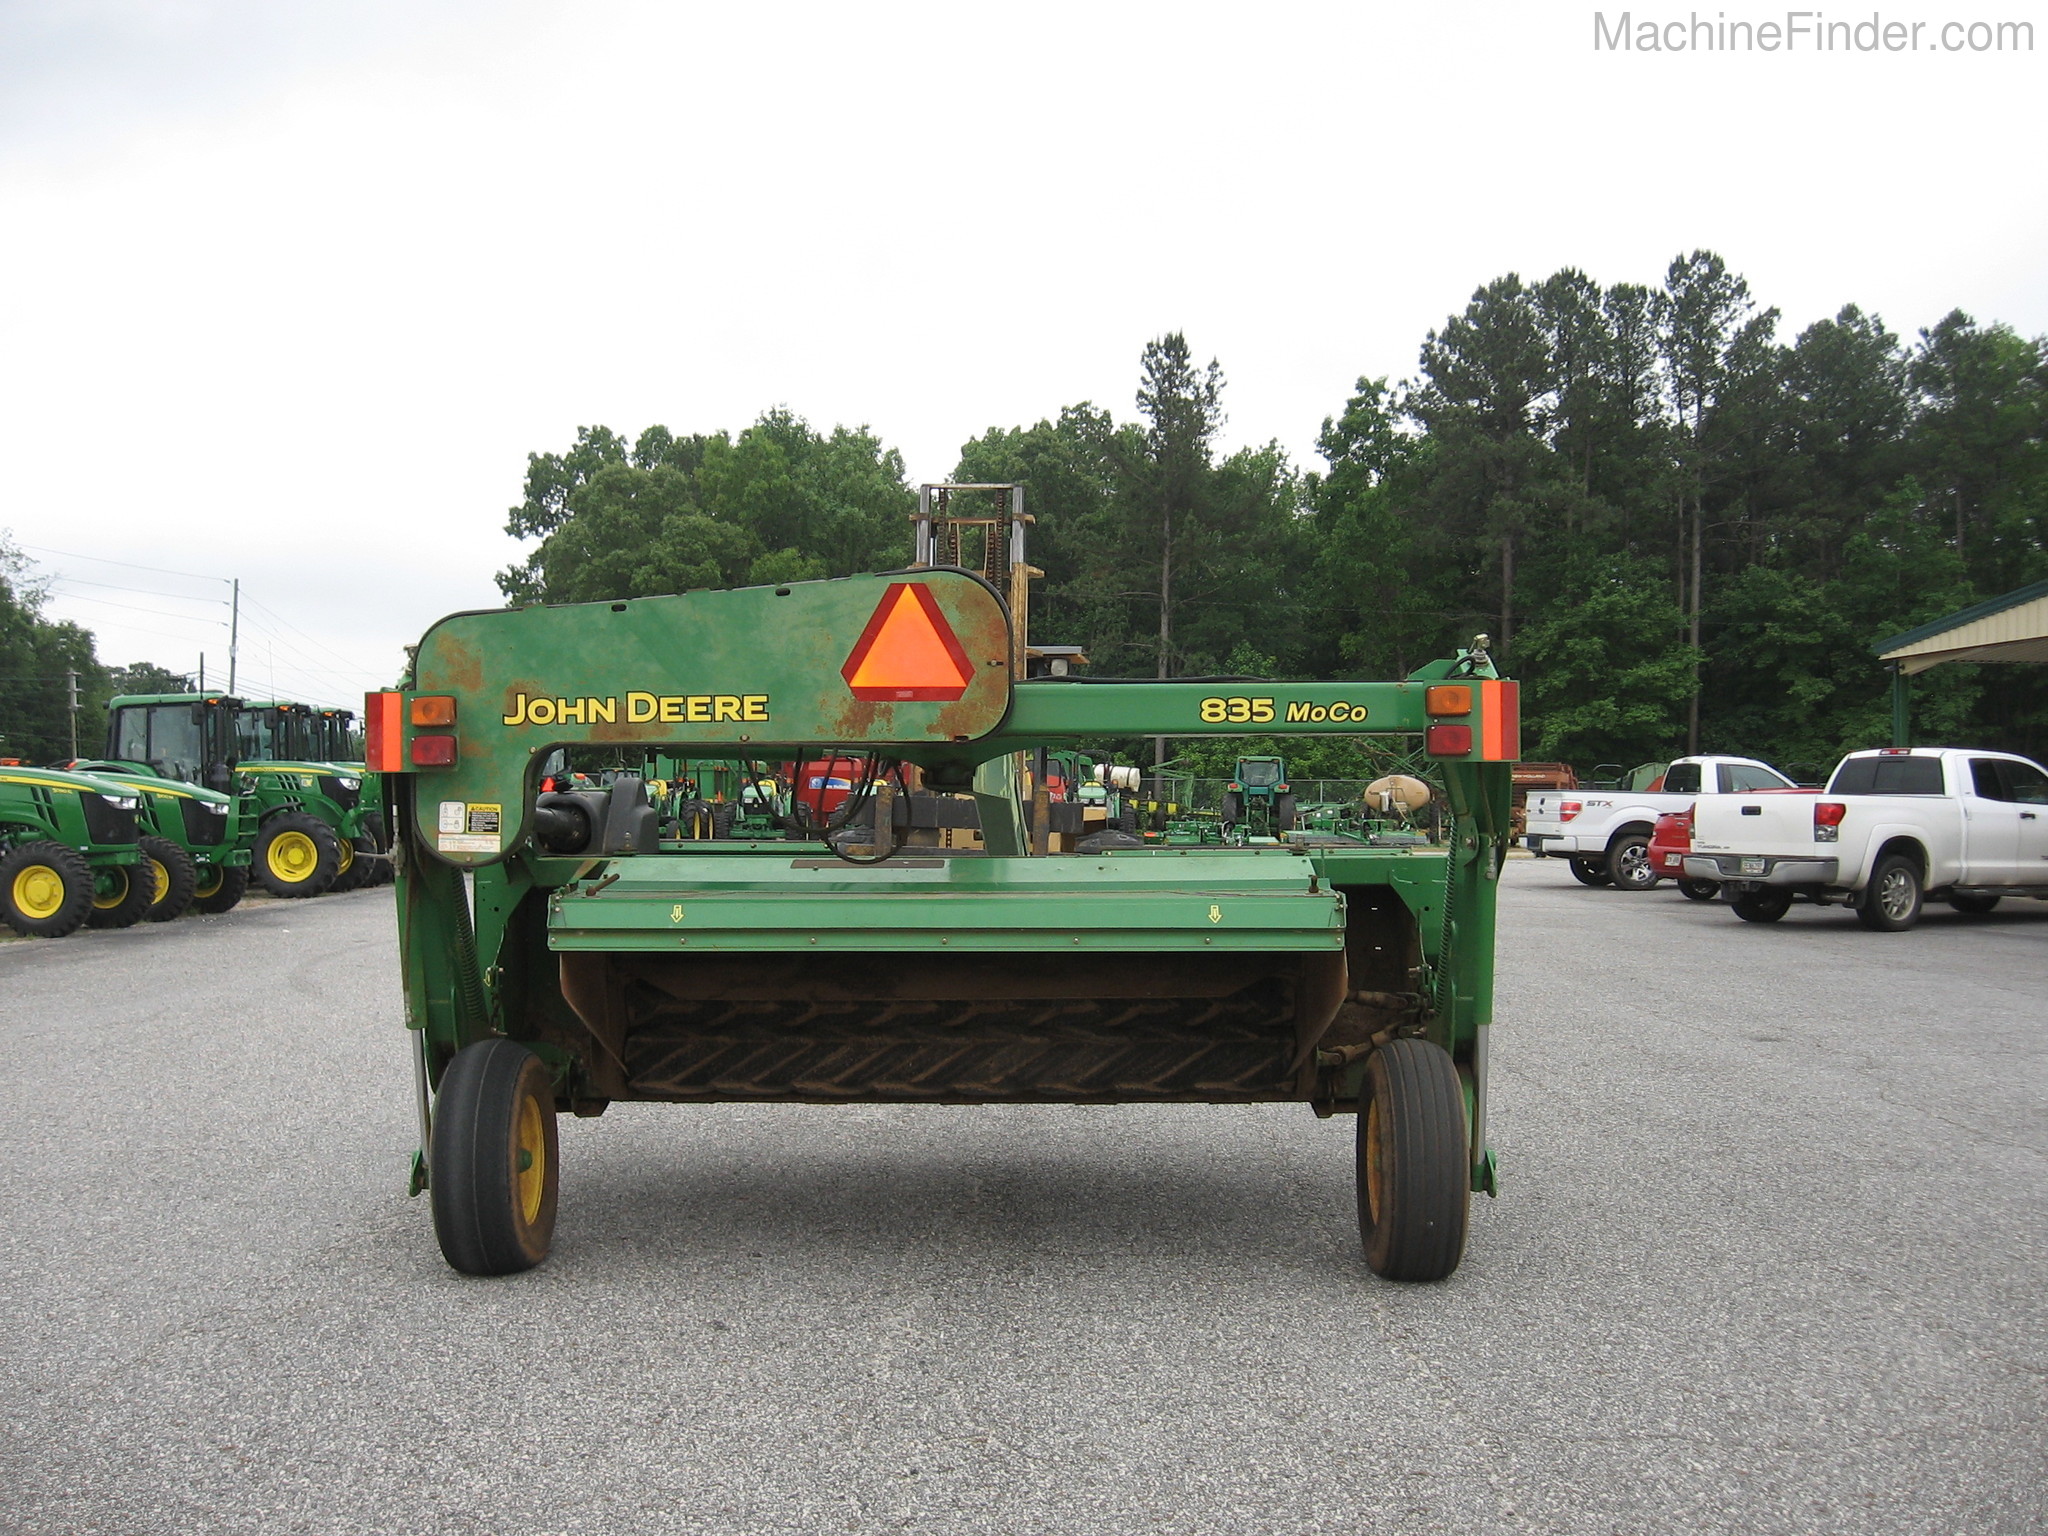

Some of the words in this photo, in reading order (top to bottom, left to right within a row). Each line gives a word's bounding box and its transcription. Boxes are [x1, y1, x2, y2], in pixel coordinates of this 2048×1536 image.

[503, 693, 617, 726] JOHN
[626, 691, 769, 723] DEERE
[1200, 696, 1276, 723] 835
[1284, 700, 1368, 723] MoCo
